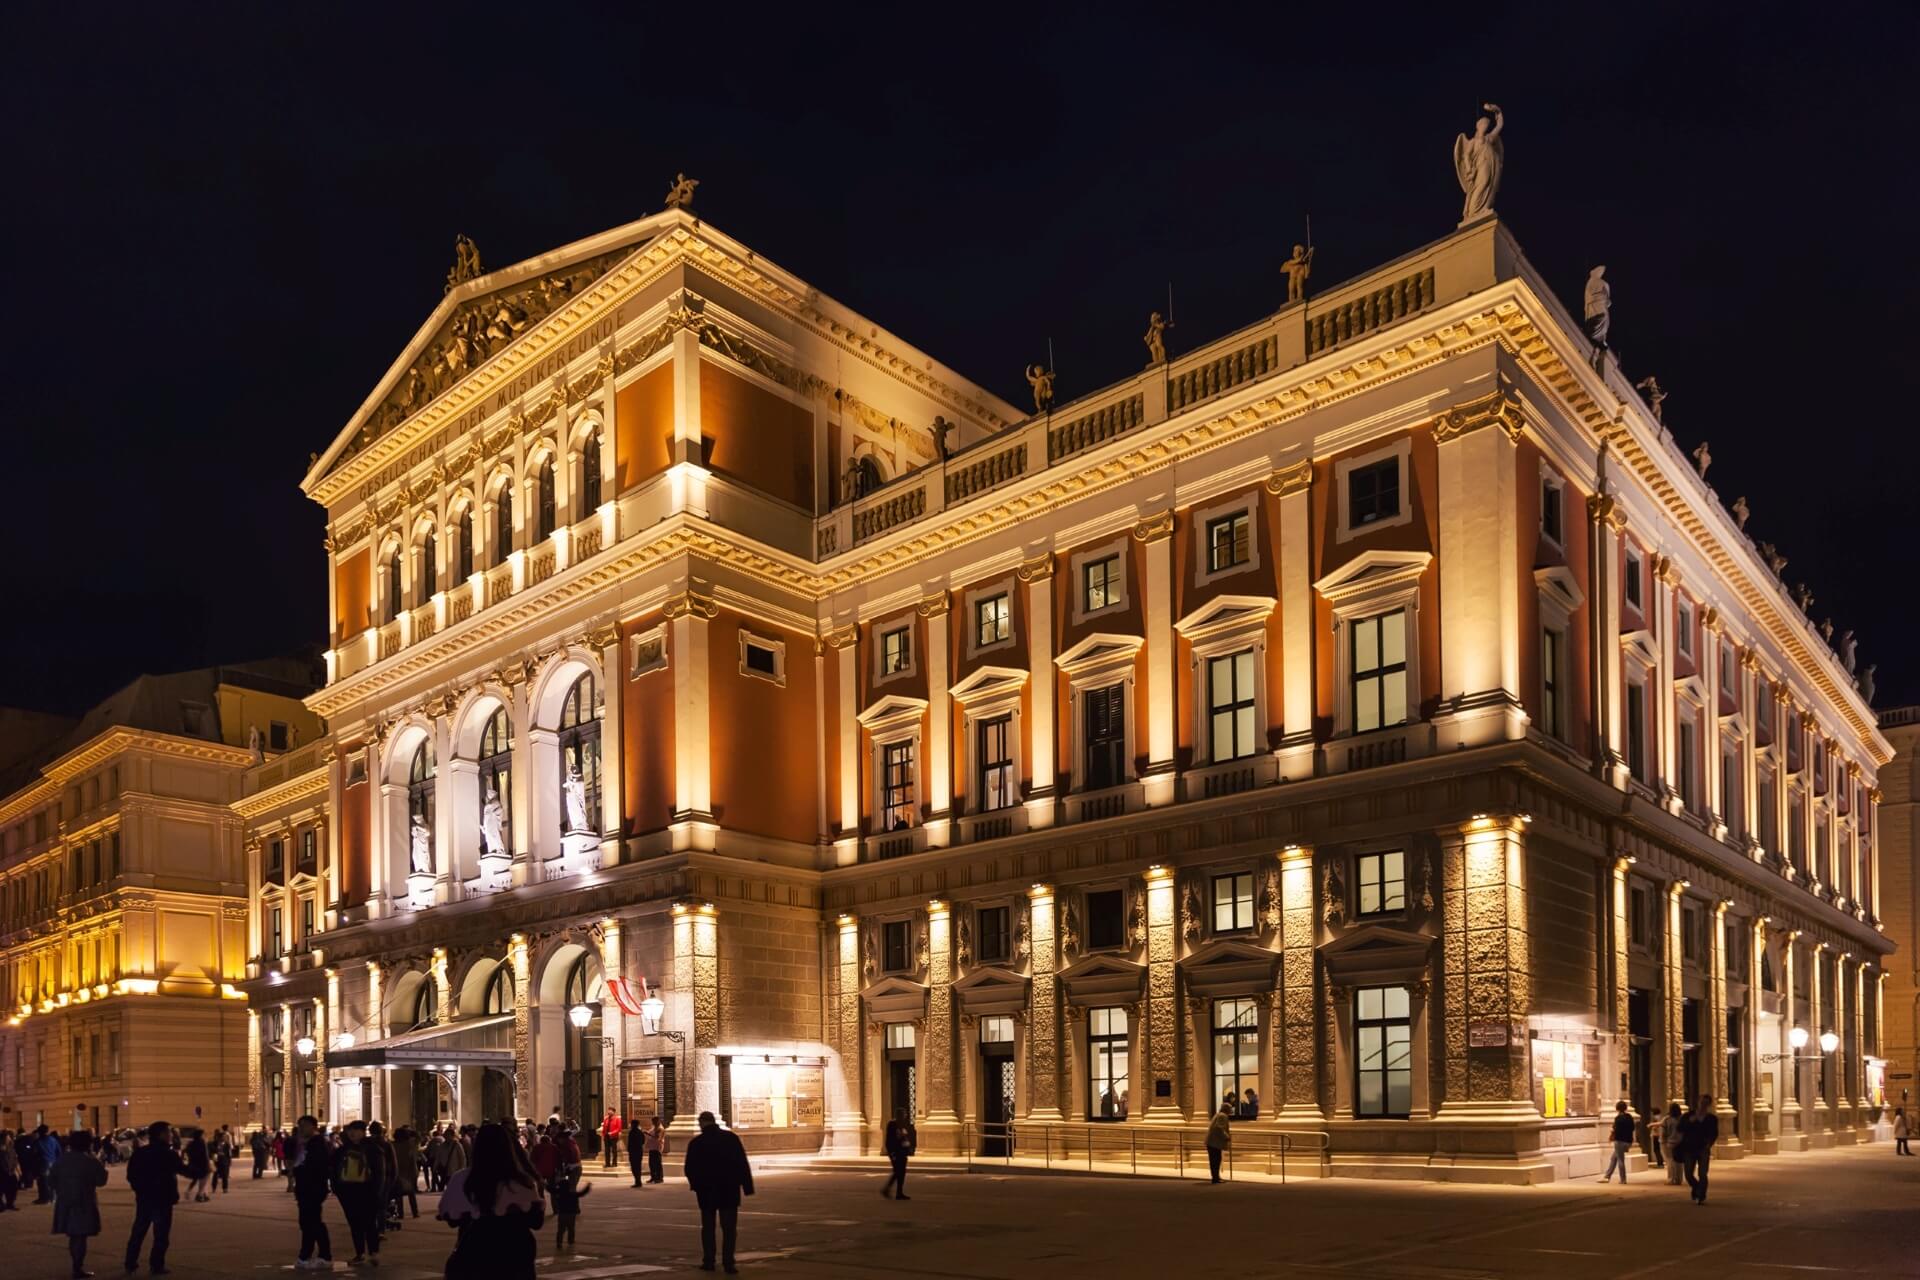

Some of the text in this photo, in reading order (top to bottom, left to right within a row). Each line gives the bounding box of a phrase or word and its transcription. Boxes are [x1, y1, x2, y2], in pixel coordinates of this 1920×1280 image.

[360, 310, 625, 501] GESELLSCHAFT DER MUSIKFREUNDE
